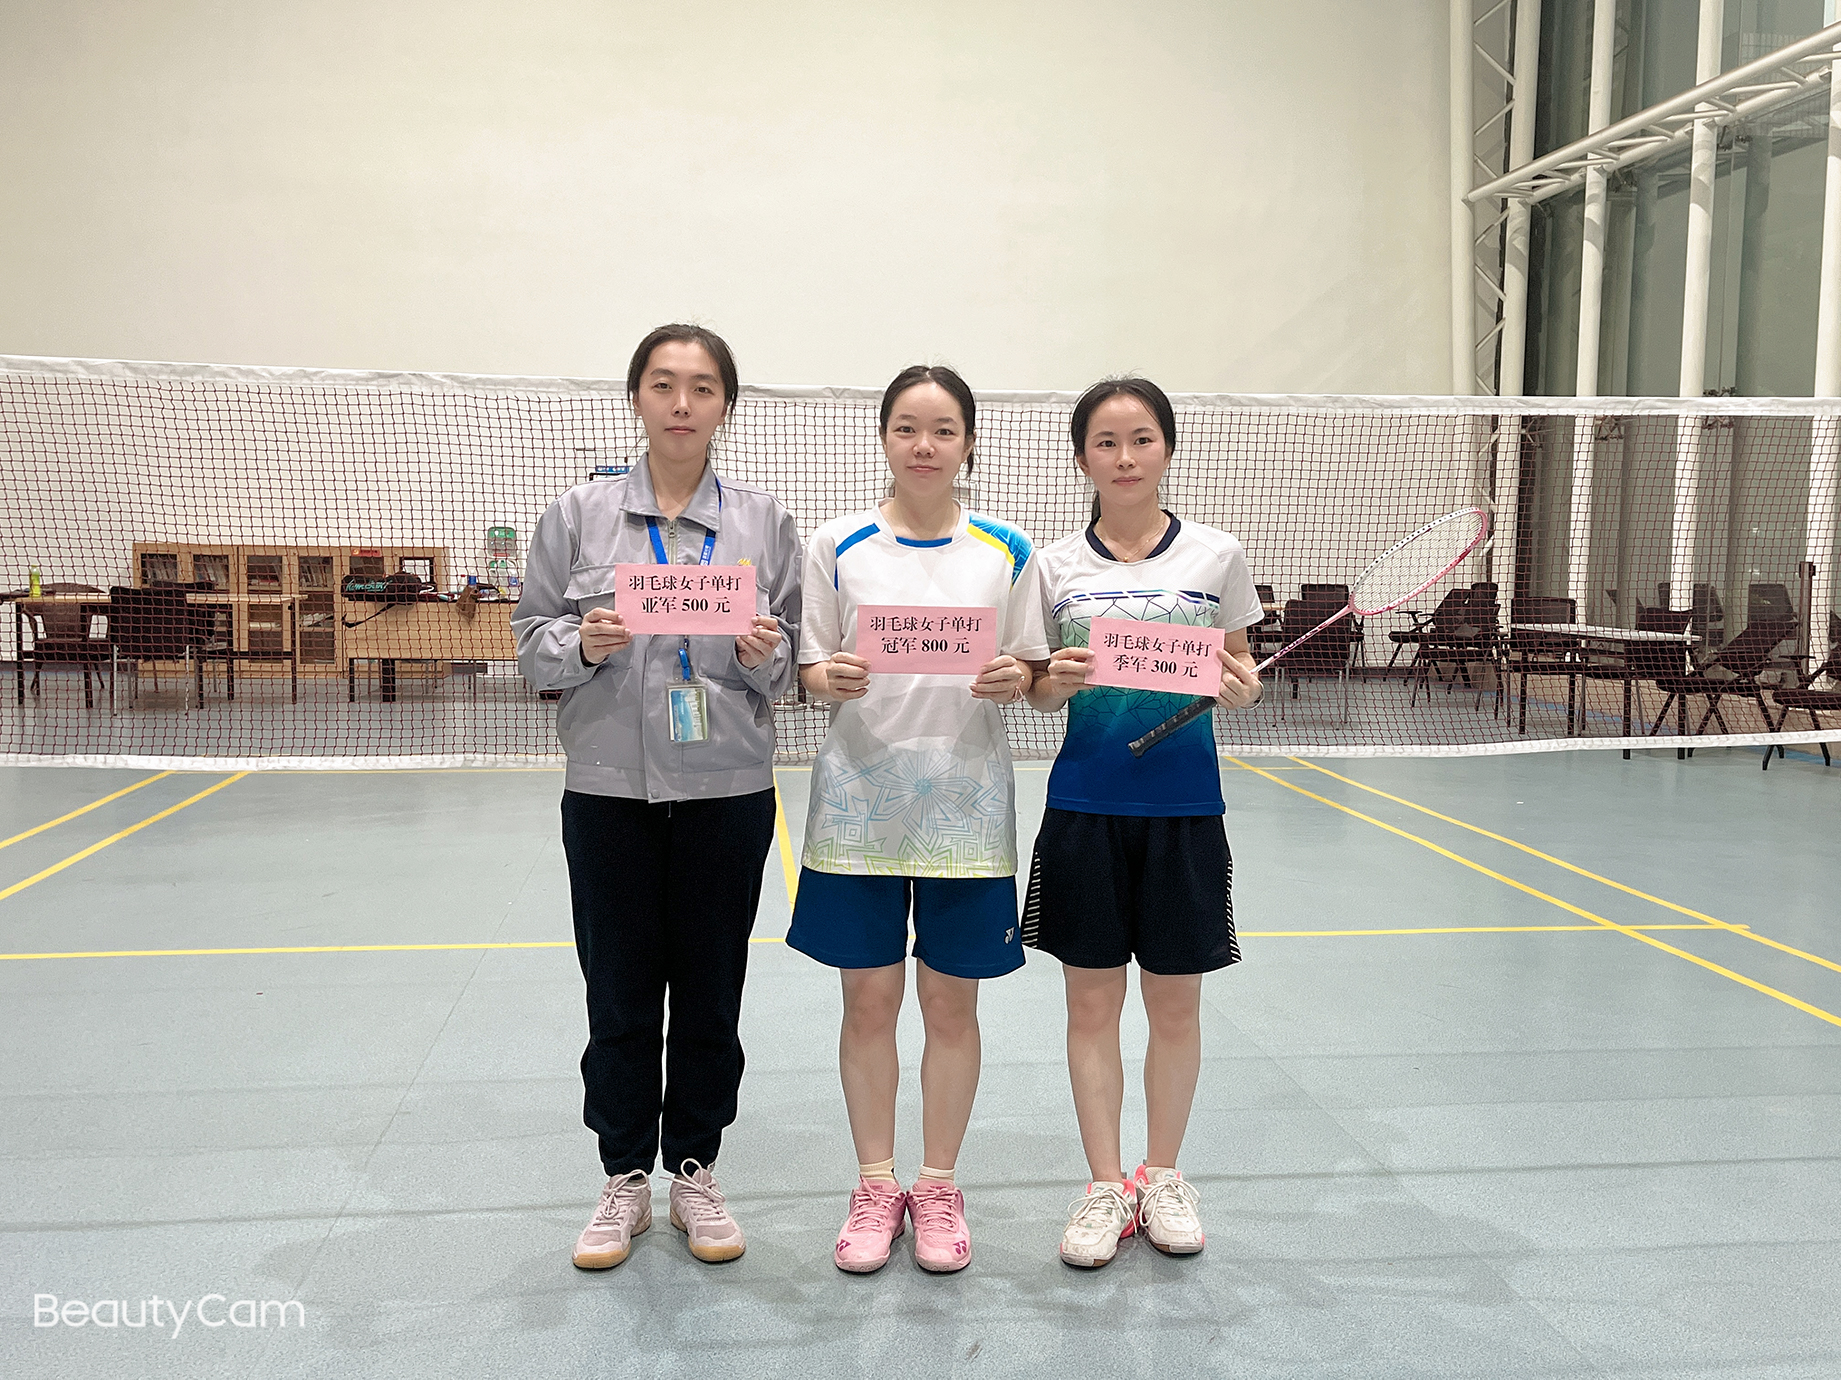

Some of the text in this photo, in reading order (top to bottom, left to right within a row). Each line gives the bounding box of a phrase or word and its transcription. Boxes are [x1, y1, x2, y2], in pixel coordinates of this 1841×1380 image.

[628, 574, 742, 592] 羽毛球女子单打
[641, 596, 731, 614] 亚军 500 元
[869, 616, 983, 633] 羽毛球女子单打
[881, 636, 970, 654] 冠军 800 元
[1103, 632, 1213, 657] 羽毛球女子单打
[1113, 654, 1199, 678] 季军 300 元
